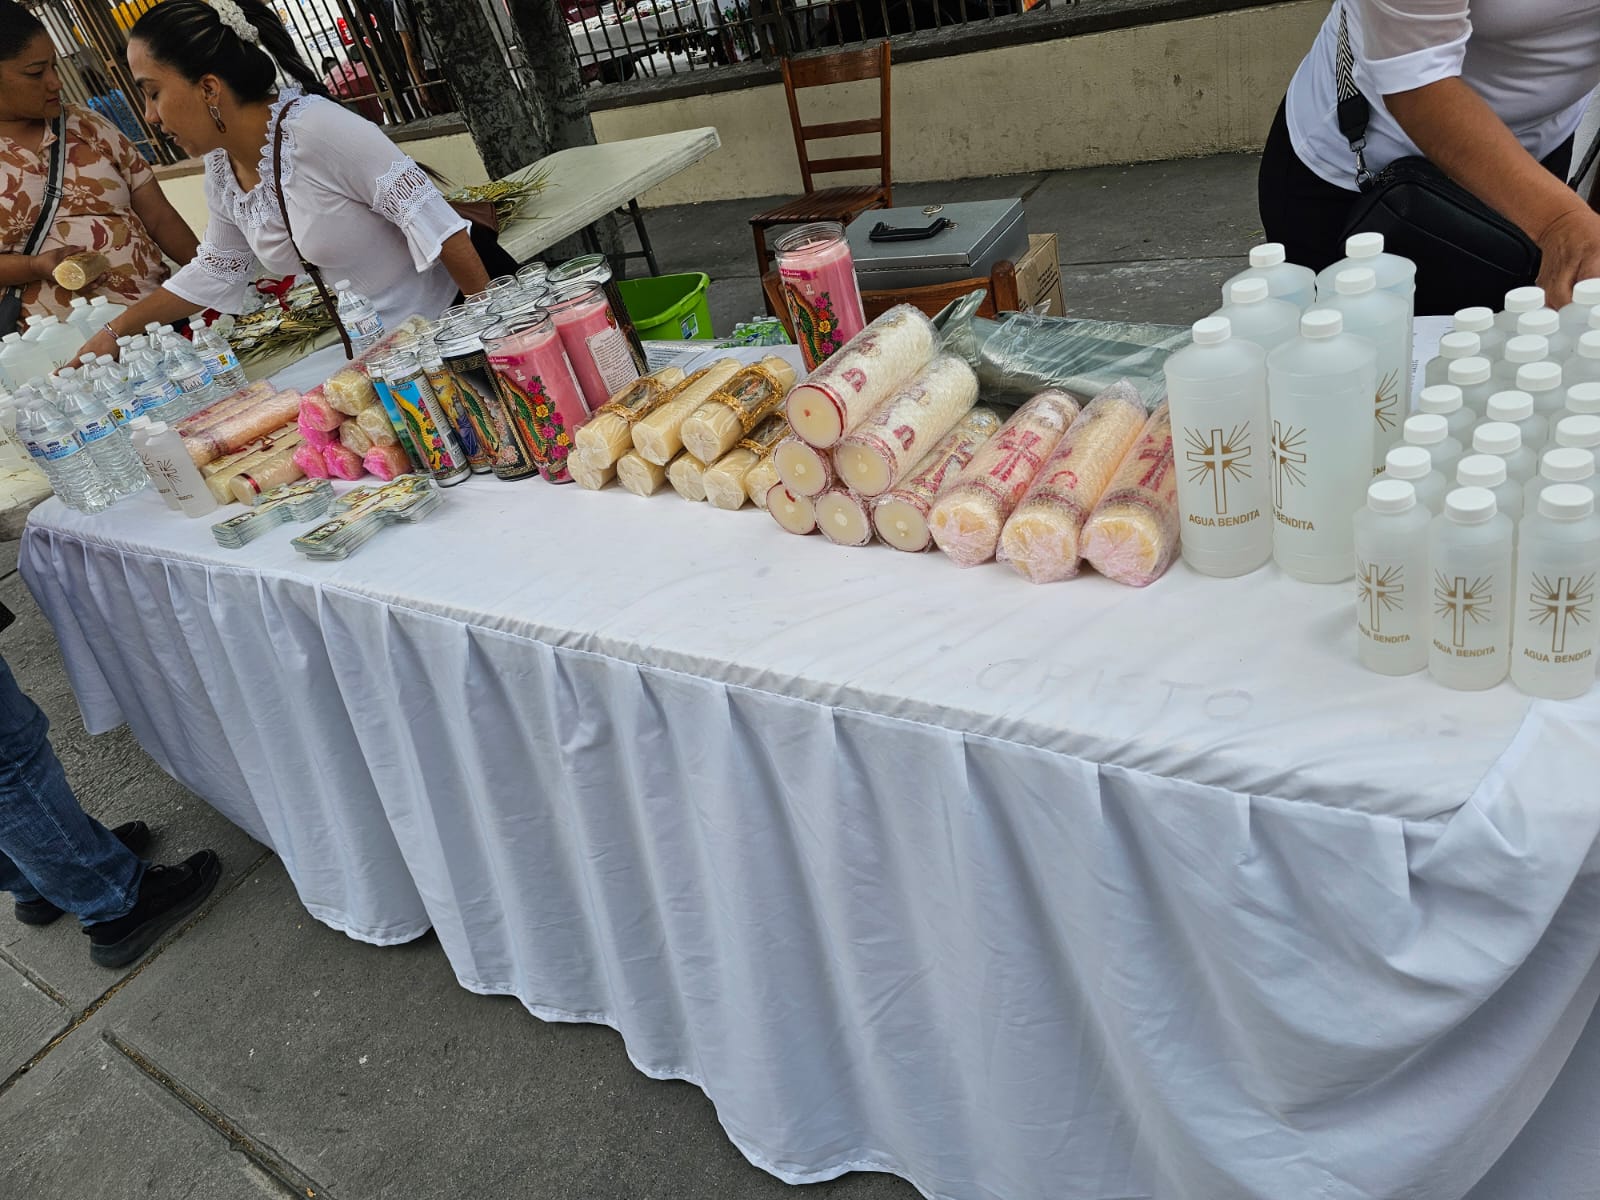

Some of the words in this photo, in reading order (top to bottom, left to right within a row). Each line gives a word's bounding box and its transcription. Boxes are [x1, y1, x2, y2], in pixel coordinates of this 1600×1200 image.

[1188, 513, 1216, 527] AGUA
[1217, 508, 1260, 527] BENDITA
[1276, 510, 1316, 532] BENDITA
[1373, 634, 1411, 644] BENDITA
[1455, 645, 1496, 657] BENDITA
[1523, 647, 1550, 662] AGUA
[1554, 648, 1592, 663] BENDITA
